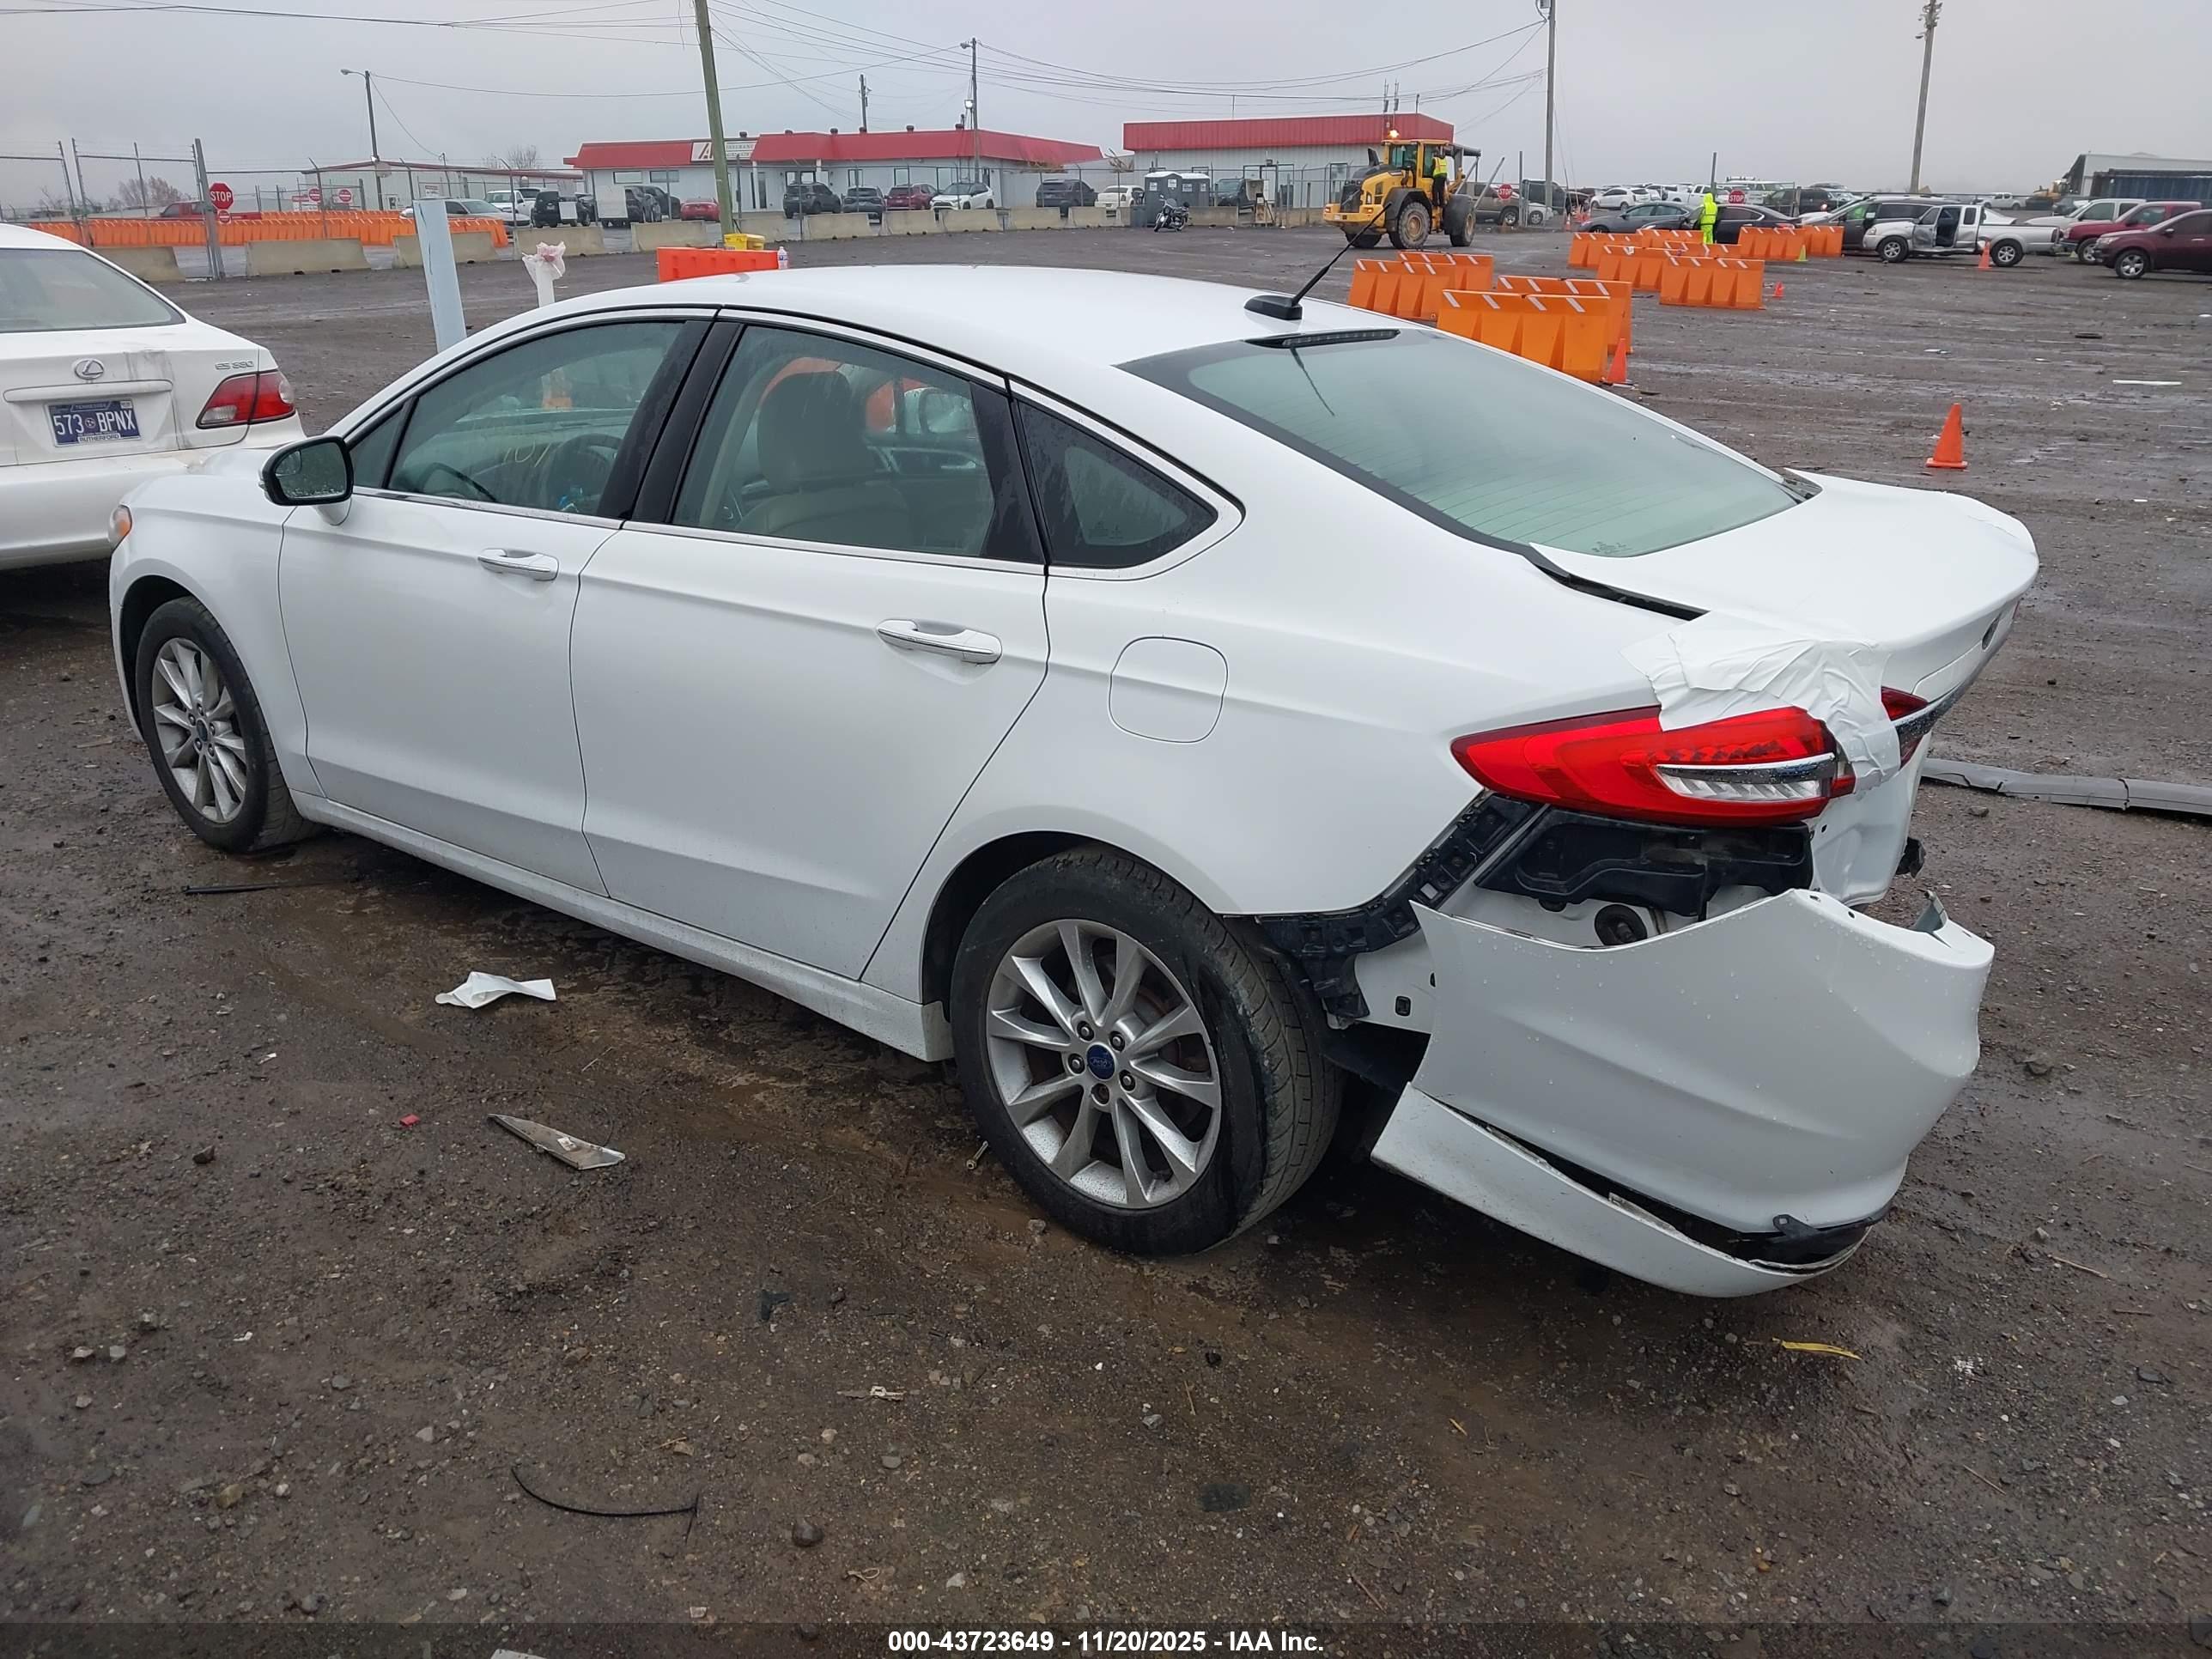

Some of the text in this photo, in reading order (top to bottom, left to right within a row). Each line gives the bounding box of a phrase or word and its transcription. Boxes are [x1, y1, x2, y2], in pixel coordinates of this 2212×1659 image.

[210, 191, 232, 202] STOP
[1729, 194, 1744, 203] STOP
[53, 410, 136, 435] 573 BPNX
